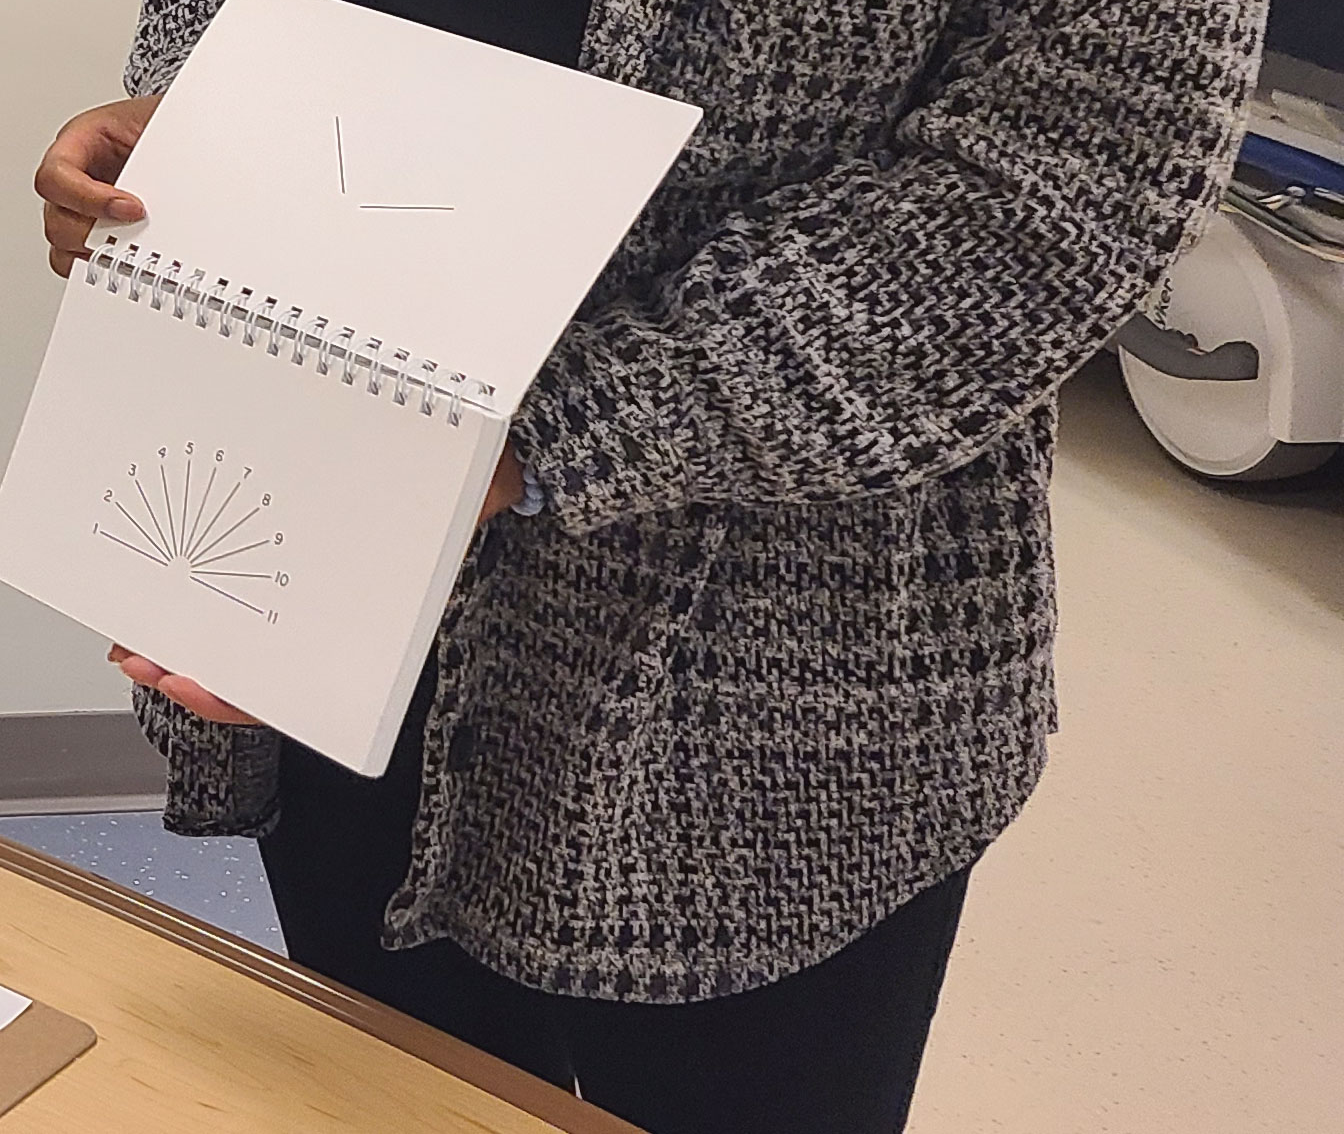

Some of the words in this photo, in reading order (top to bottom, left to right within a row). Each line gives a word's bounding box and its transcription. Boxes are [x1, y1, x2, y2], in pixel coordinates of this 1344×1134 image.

[158, 447, 167, 459] 4
[186, 442, 194, 455] 5
[216, 450, 225, 462] 6
[128, 464, 138, 477] 3
[244, 467, 253, 480] 7
[103, 490, 113, 502] 2
[262, 494, 272, 506] 8
[93, 523, 99, 534] 1
[274, 533, 284, 545] 9
[275, 571, 289, 587] 10
[267, 611, 279, 625] 11
